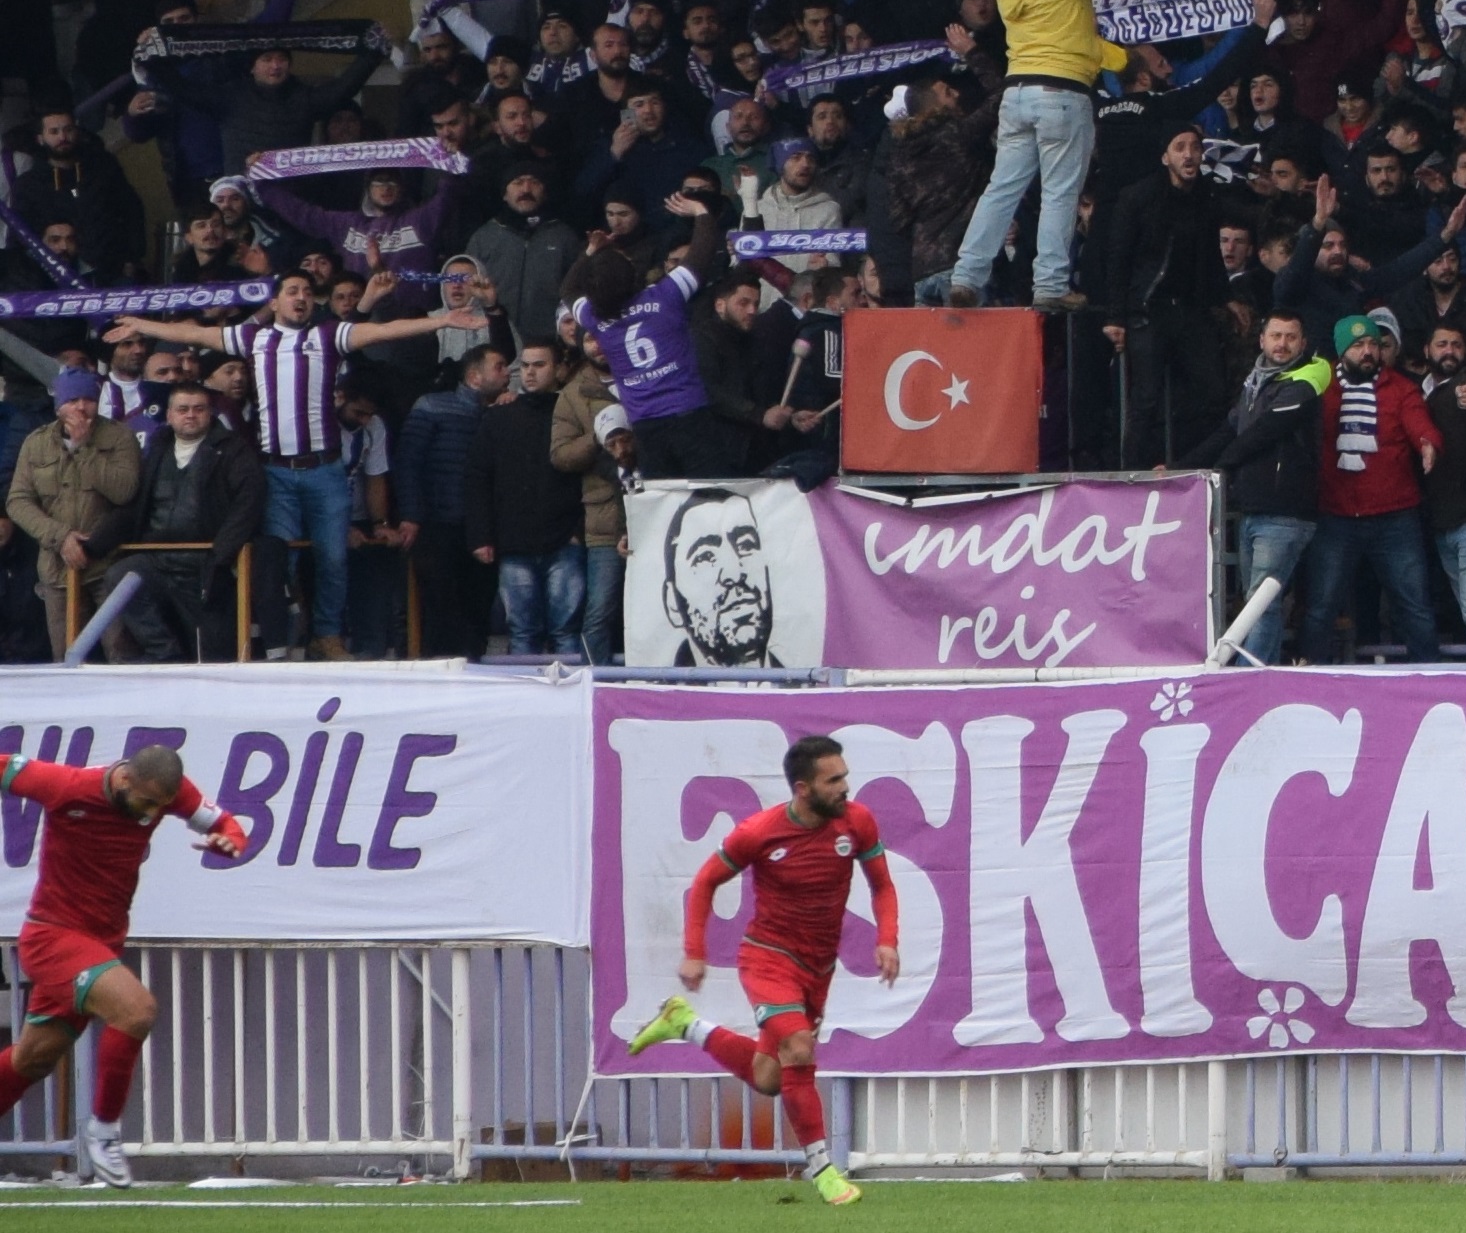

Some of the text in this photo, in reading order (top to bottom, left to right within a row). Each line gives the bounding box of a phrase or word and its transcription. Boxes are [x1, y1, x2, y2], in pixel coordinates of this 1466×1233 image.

[785, 47, 947, 88] GEBZESPOR
[275, 142, 411, 170] GEBZESPOR
[35, 289, 234, 316] GEBZESPOR
[624, 321, 659, 369] 6
[939, 585, 1096, 670] reis
[201, 696, 458, 872] BİLE
